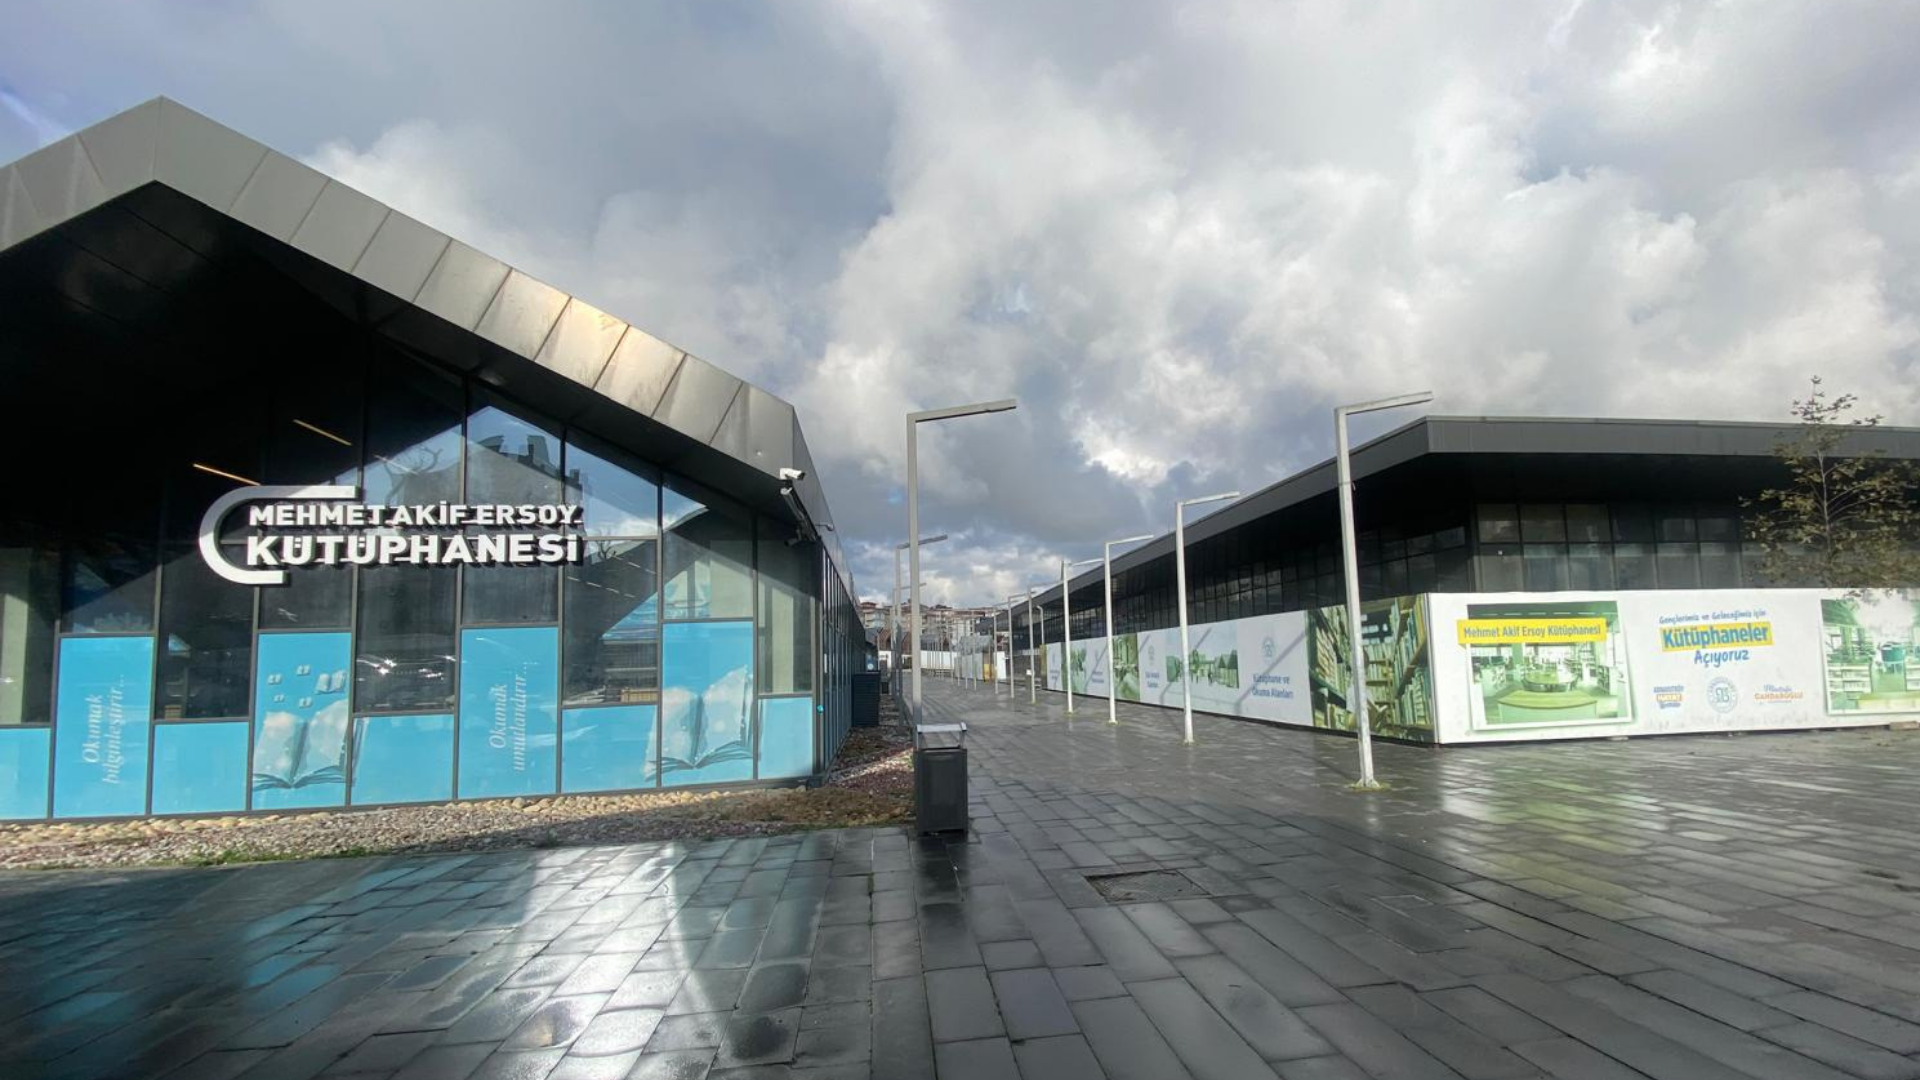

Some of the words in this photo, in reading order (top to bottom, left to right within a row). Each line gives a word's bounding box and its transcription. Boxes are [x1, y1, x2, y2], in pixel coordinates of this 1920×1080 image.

[249, 505, 387, 526] MEHMET
[389, 500, 475, 526] AKİF
[477, 503, 578, 526] ERSOY
[246, 533, 579, 566] KÜTÜPHANESİ
[1463, 626, 1501, 638] Mehmet
[1503, 625, 1519, 637] Akif
[1522, 625, 1546, 638] Ersoy
[1547, 624, 1601, 637] Kütüphanesi
[1662, 623, 1769, 649] Kütüphaneler
[1694, 649, 1750, 668] Açıyoruz
[82, 695, 103, 763] Okumak
[488, 684, 508, 749] Okumak
